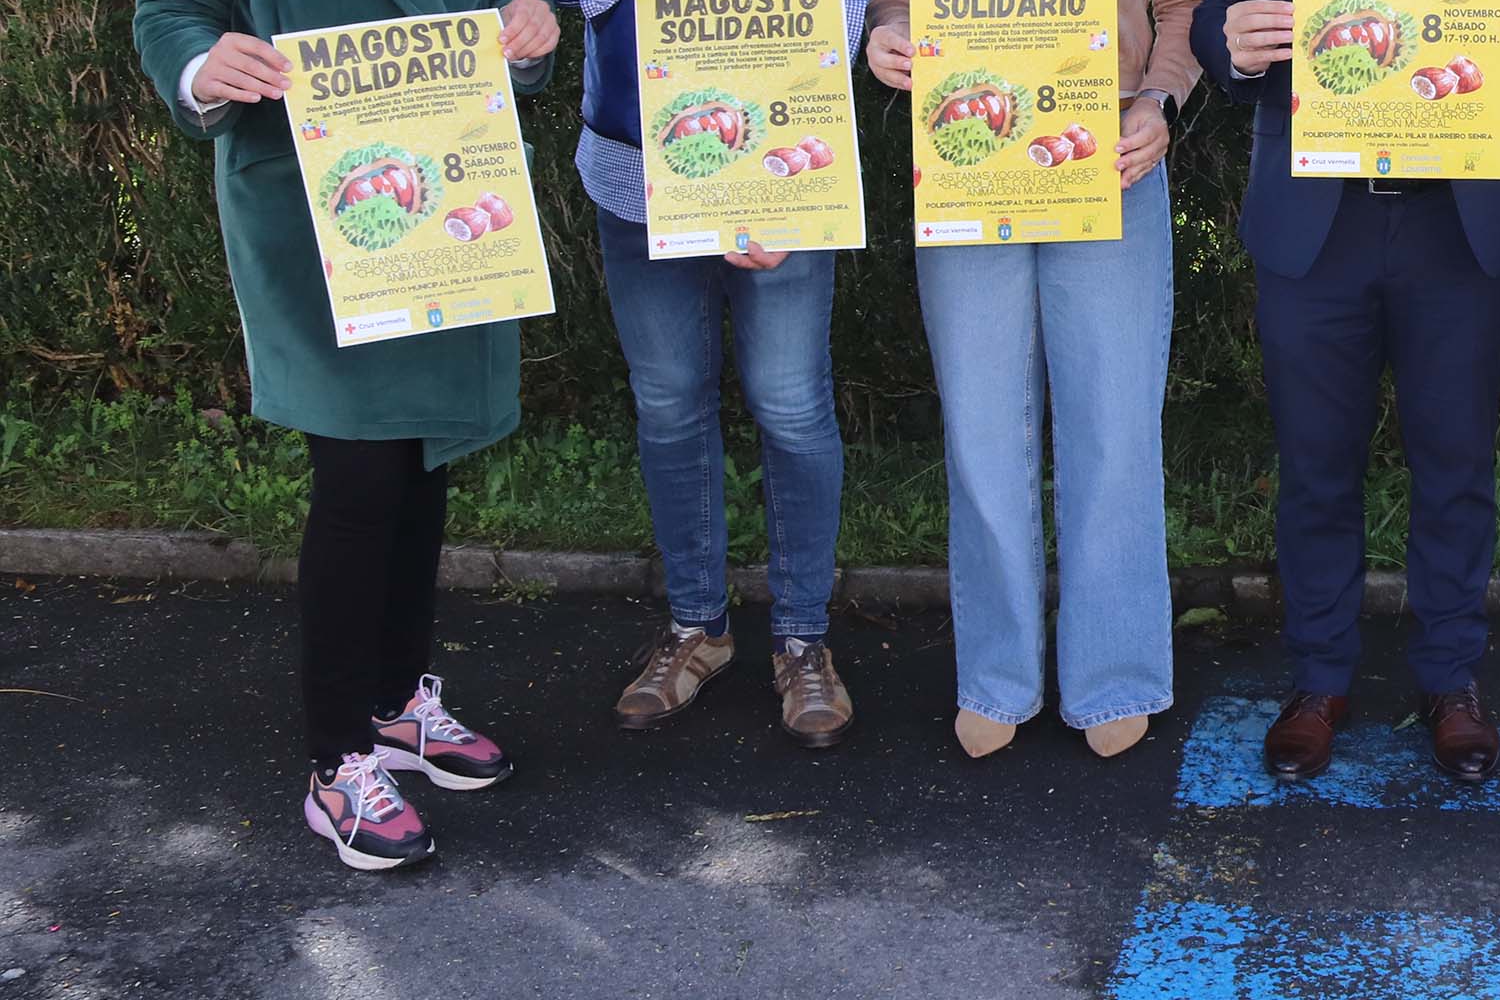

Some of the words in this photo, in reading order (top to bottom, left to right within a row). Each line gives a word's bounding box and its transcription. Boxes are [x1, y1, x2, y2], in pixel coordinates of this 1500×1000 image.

[660, 12, 814, 44] SOLIDARIO
[1421, 14, 1443, 43] 8
[297, 18, 479, 72] MAGOSTO
[1444, 34, 1487, 43] 17-19.00
[311, 49, 476, 101] SOLIDARIO
[1057, 78, 1114, 88] NOVEMBRO
[789, 92, 847, 103] NOVEMBRO
[1037, 85, 1057, 113] 8
[1058, 102, 1099, 112] 17-19.00
[769, 101, 790, 127] 8
[791, 115, 834, 126] 17-19.00
[461, 141, 518, 155] NOVEMBRO
[444, 152, 465, 183] 8
[466, 167, 508, 181] 17-19.00
